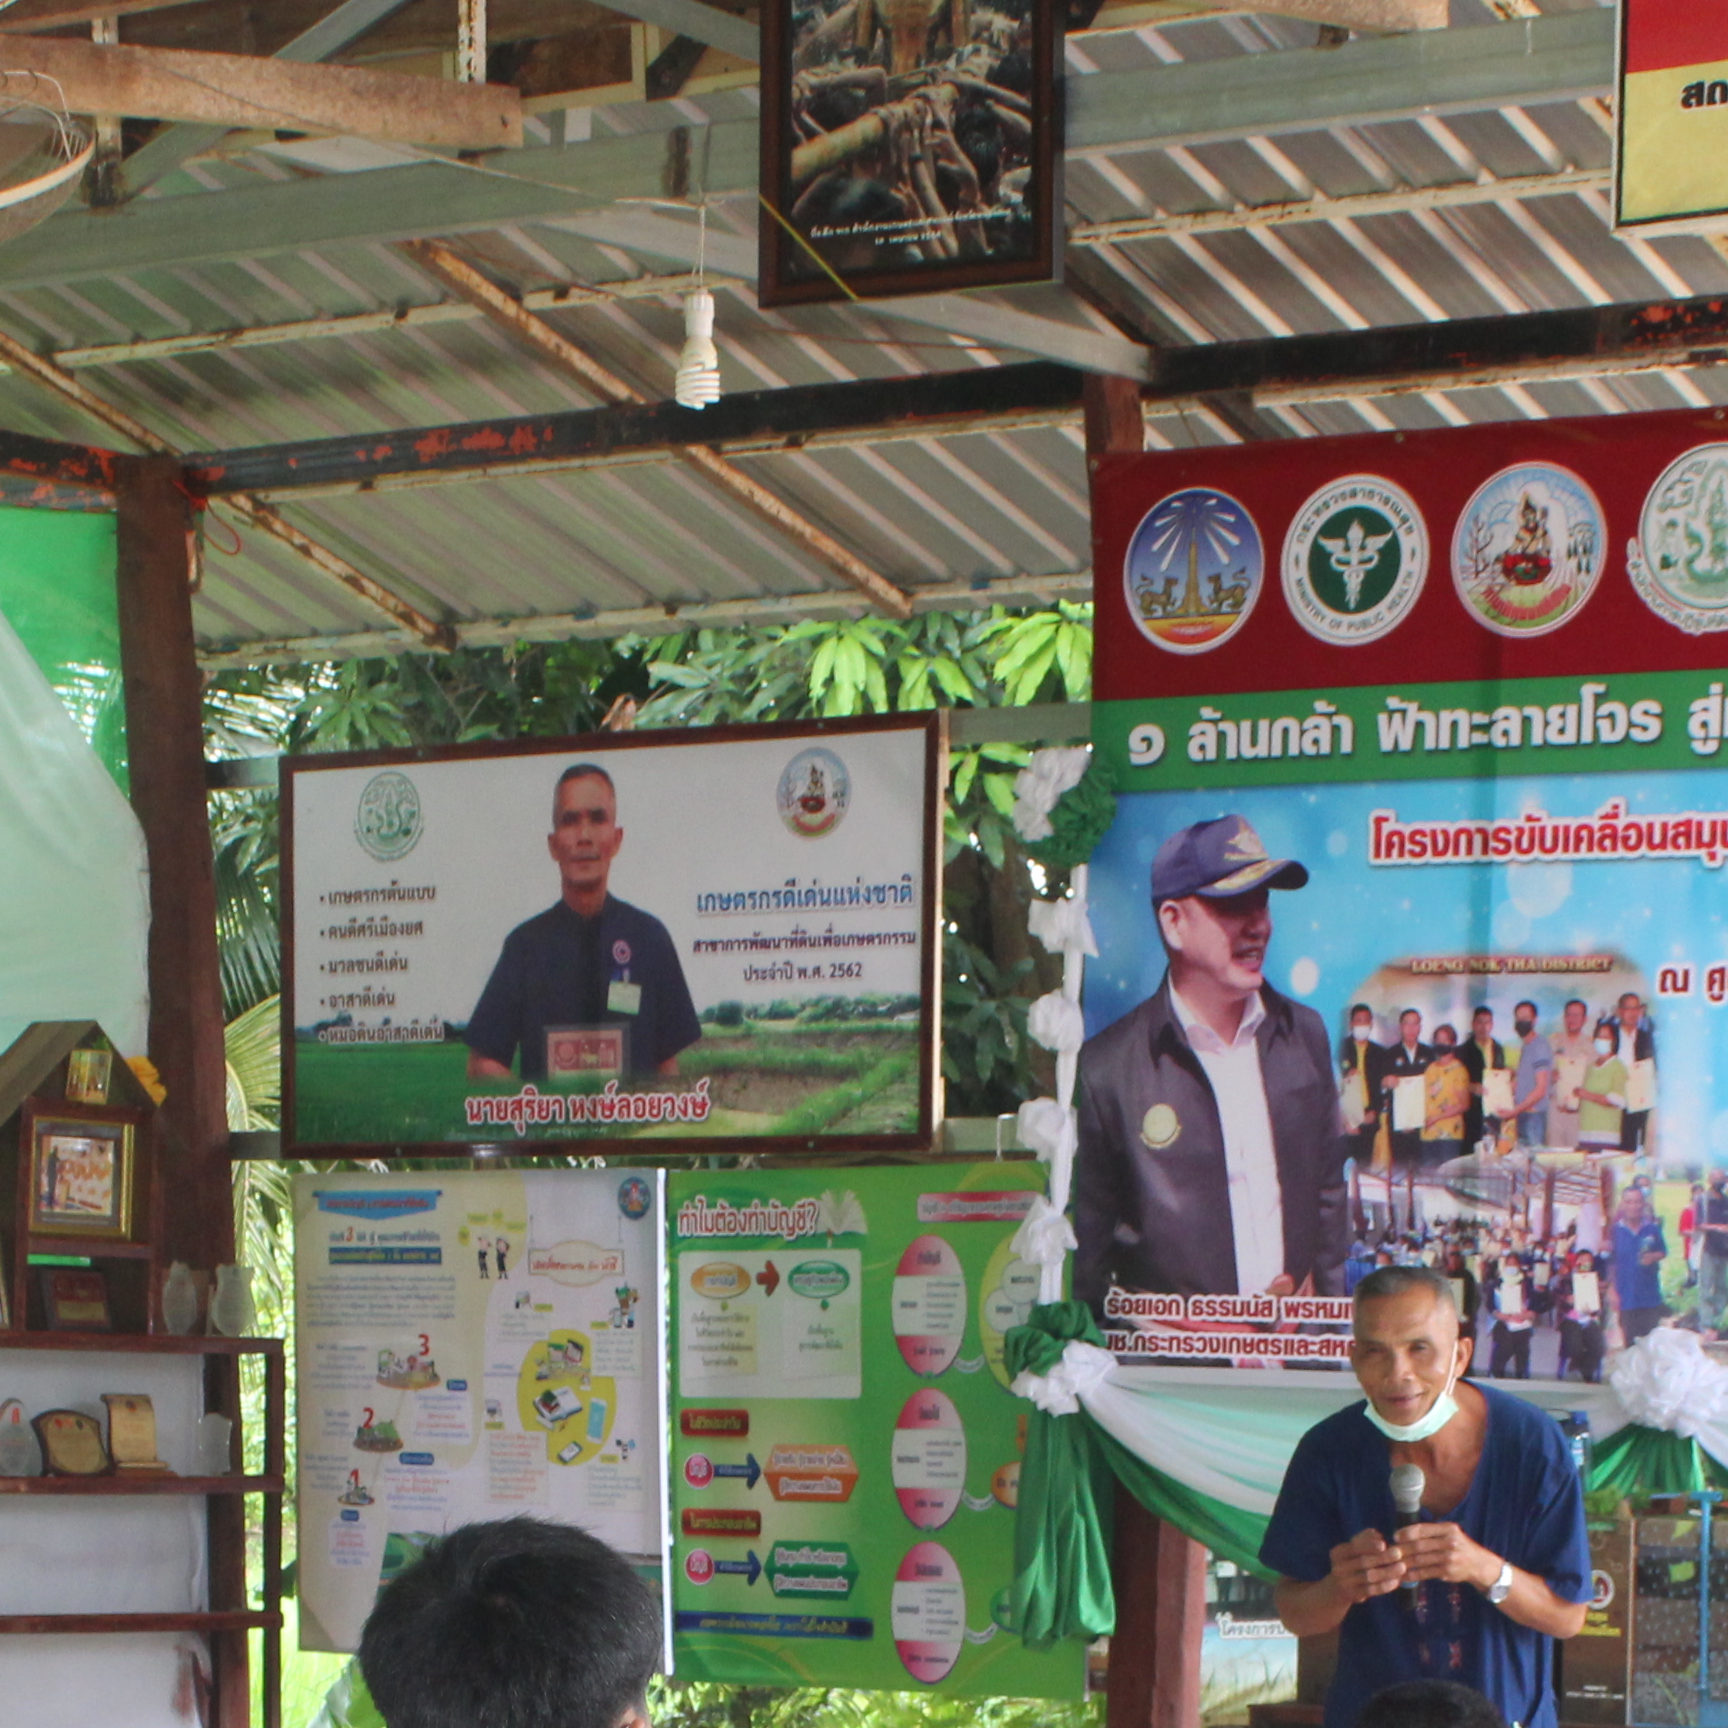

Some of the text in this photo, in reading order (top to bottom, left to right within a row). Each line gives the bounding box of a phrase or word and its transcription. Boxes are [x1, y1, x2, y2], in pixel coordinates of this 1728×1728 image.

[1346, 610, 1385, 634] PUBLIC
[1127, 723, 1166, 766] ๑
[1186, 700, 1355, 763] ล้านกล้า
[1376, 683, 1664, 754] ฟ้าทะลายโจร
[328, 878, 436, 905] เกษตรกรต้นแบบ
[696, 873, 914, 913] เกษตรกรดีเด่นแห่งชาติ
[328, 914, 425, 939] คนดีศรีเมืองยศ
[692, 923, 917, 954] สาขาการพัฒนาที่ดินเพื่อเกษตรกรรม
[743, 960, 864, 983] ประจำปี พ.ศ. 2562
[1468, 957, 1503, 974] NOK
[1506, 956, 1538, 973] THA
[1541, 954, 1615, 972] DISTRICT
[1658, 965, 1690, 996] ณ
[328, 985, 396, 1009] อาสาดีเด่น
[327, 1014, 445, 1043] หมอดินอาสาดีเด่น
[465, 1084, 564, 1135] นายสุริยา
[678, 1196, 819, 1239] ทำไมต้องทำบัญชี?
[1105, 1286, 1181, 1318] ร้อยเอก
[1190, 1291, 1274, 1318] ธรรมนัส
[418, 1333, 431, 1357] 3
[362, 1407, 375, 1429] 2
[349, 1468, 360, 1487] 1
